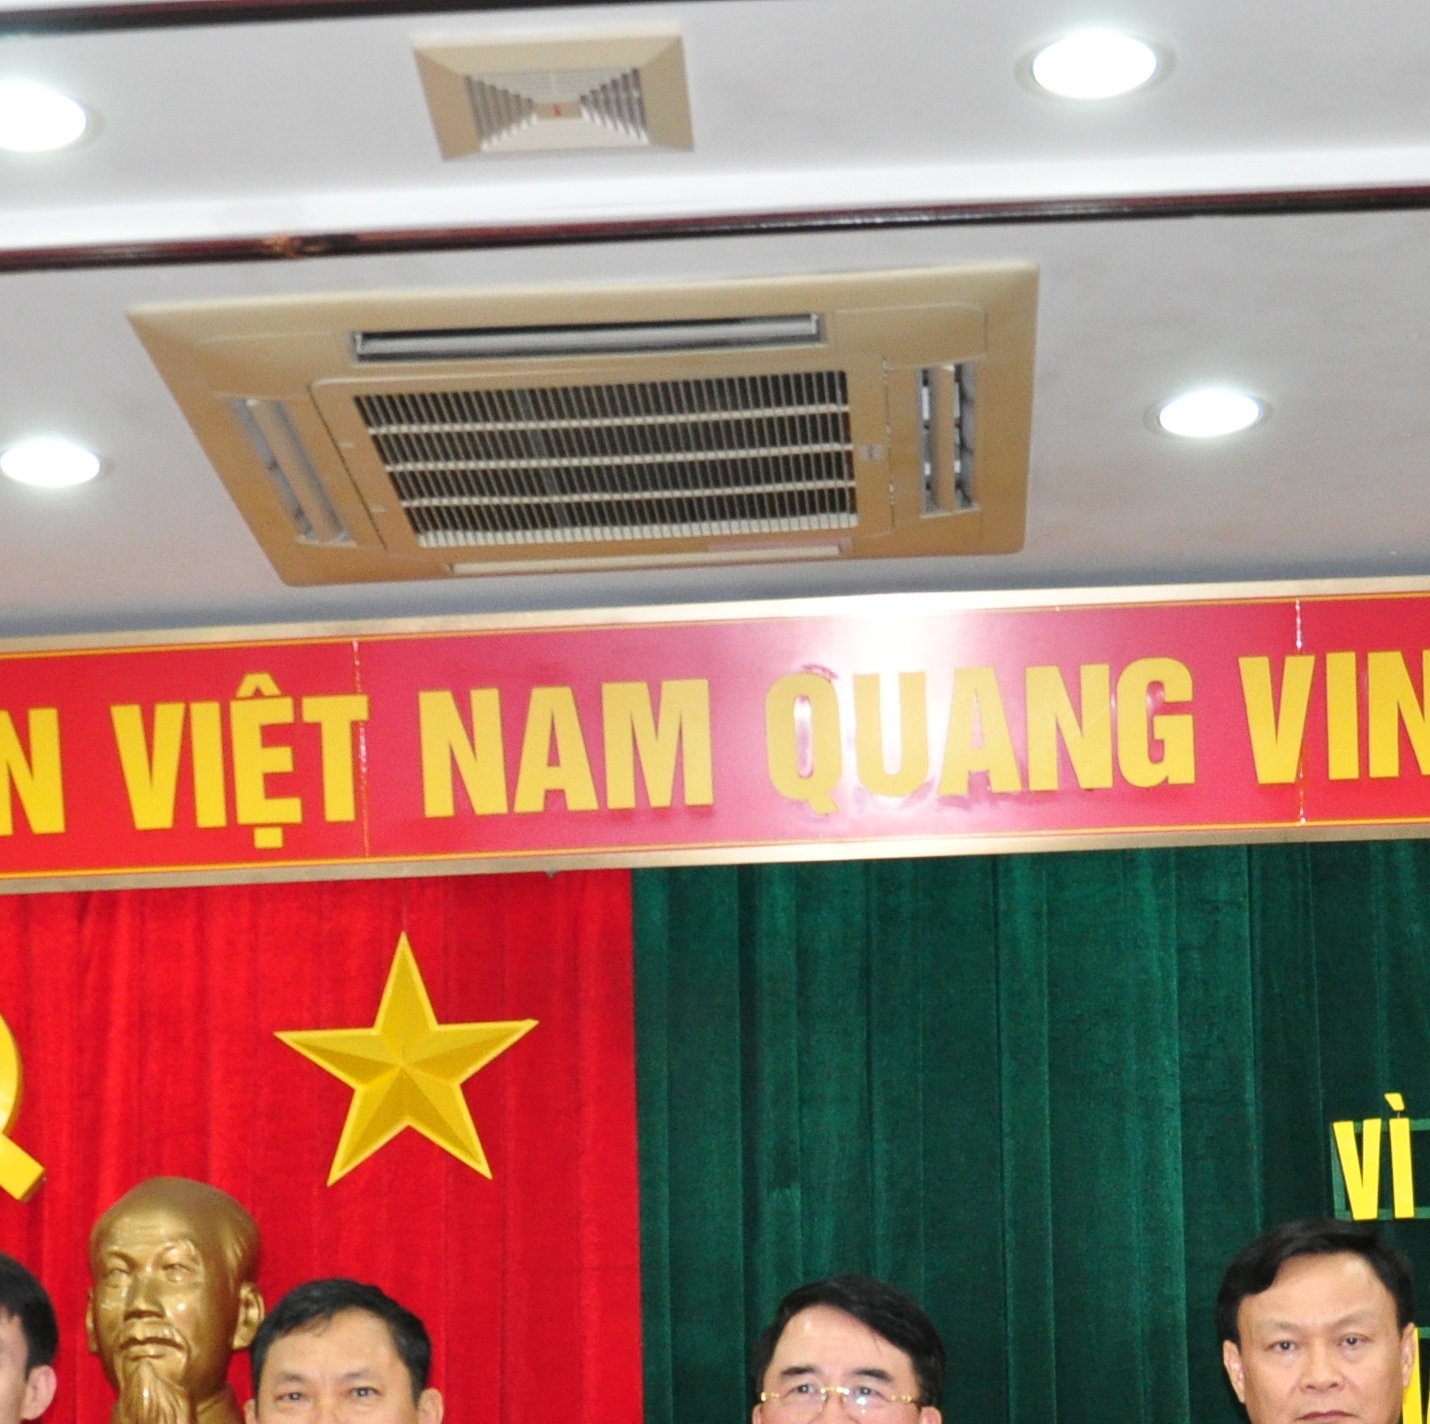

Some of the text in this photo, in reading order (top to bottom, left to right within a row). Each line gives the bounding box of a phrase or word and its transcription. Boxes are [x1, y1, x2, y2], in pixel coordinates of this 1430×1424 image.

[112, 674, 370, 848] VIỆT
[419, 680, 713, 817] NAM
[766, 657, 1196, 811] QUANG
[1332, 1092, 1415, 1221] VÌ
